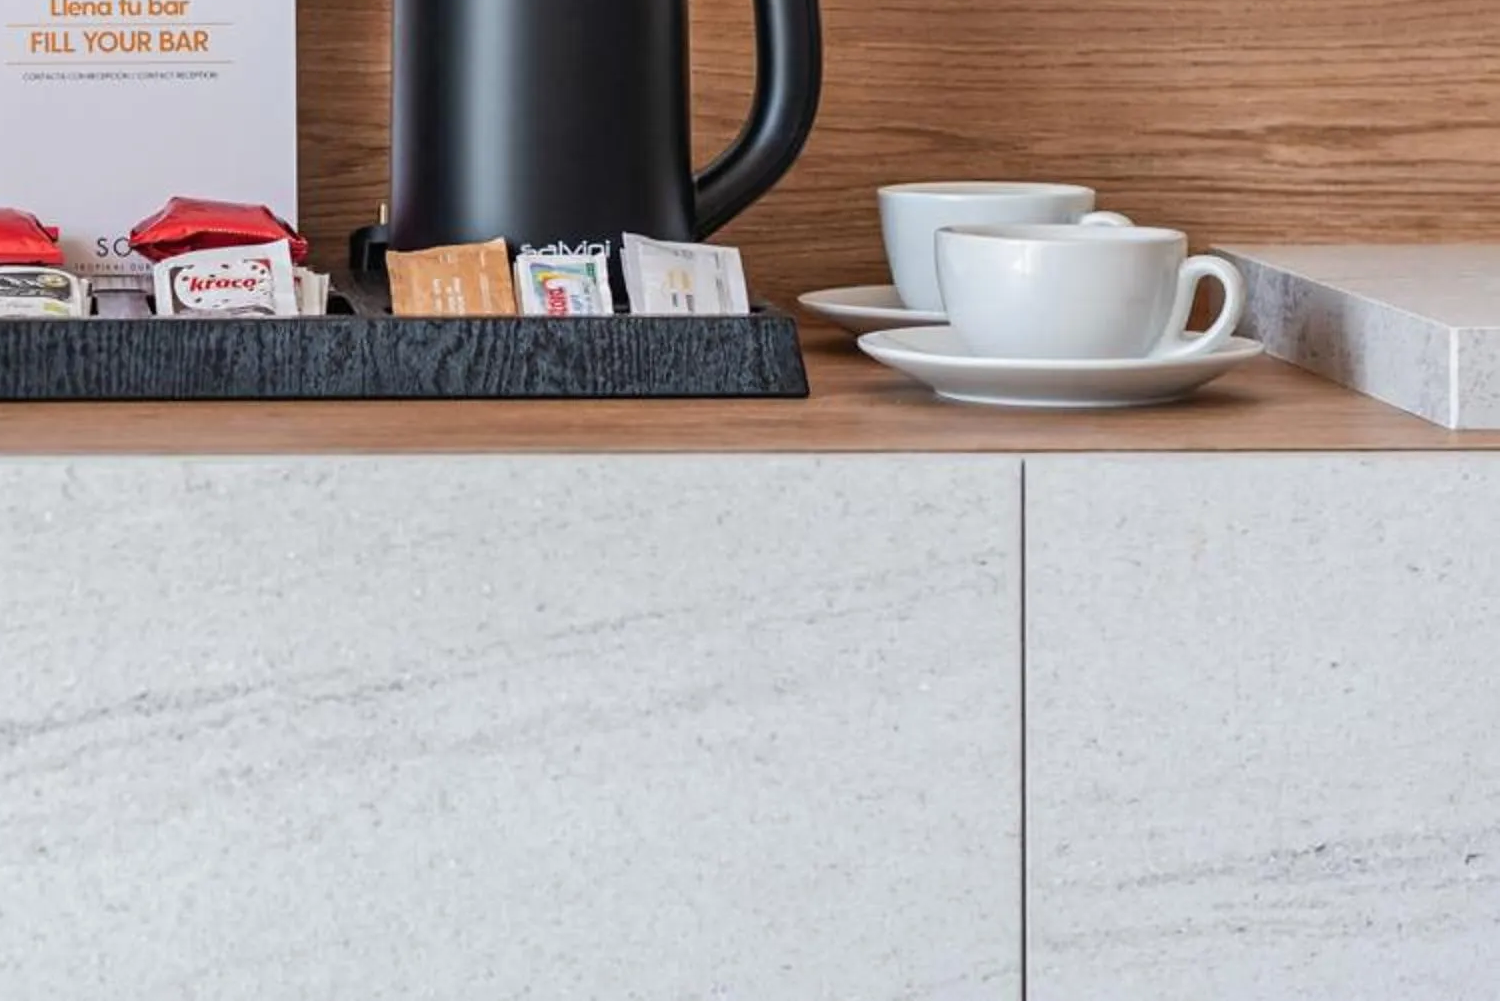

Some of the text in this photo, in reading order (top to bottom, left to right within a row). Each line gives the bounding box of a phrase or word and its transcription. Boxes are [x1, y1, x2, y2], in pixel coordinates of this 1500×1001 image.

[31, 30, 209, 53] FILL YOUR BAR
